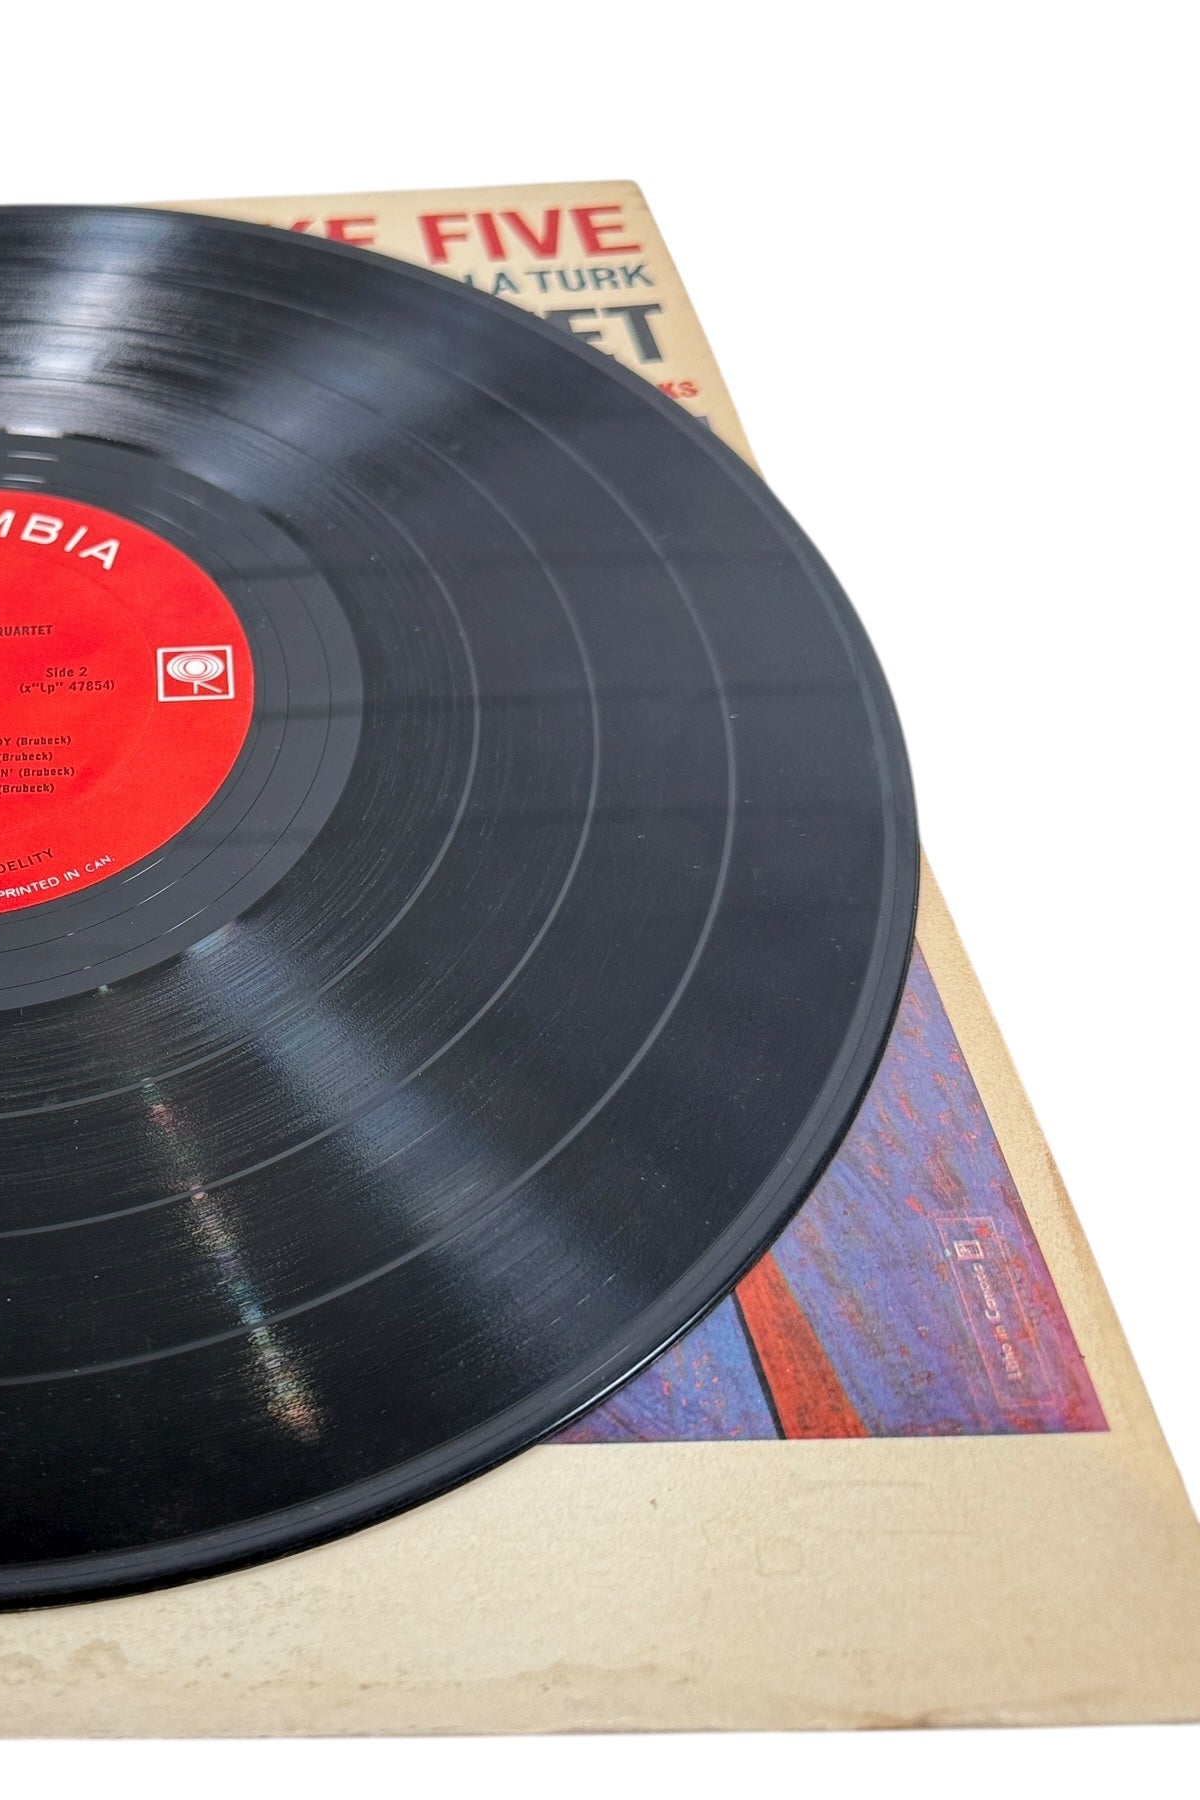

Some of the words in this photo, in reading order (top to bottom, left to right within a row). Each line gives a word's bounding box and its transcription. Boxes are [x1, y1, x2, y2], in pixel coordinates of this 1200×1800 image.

[416, 203, 642, 264] FIVE
[525, 264, 654, 294] TURK
[46, 667, 74, 678] Side
[79, 667, 88, 678] 2
[68, 680, 115, 692] 47854)
[16, 735, 72, 747] (Brubeck)
[19, 767, 75, 778] (Brubeck)
[63, 869, 80, 881] IN
[85, 854, 115, 873] CAN.
[972, 1263, 1000, 1320] Canada
